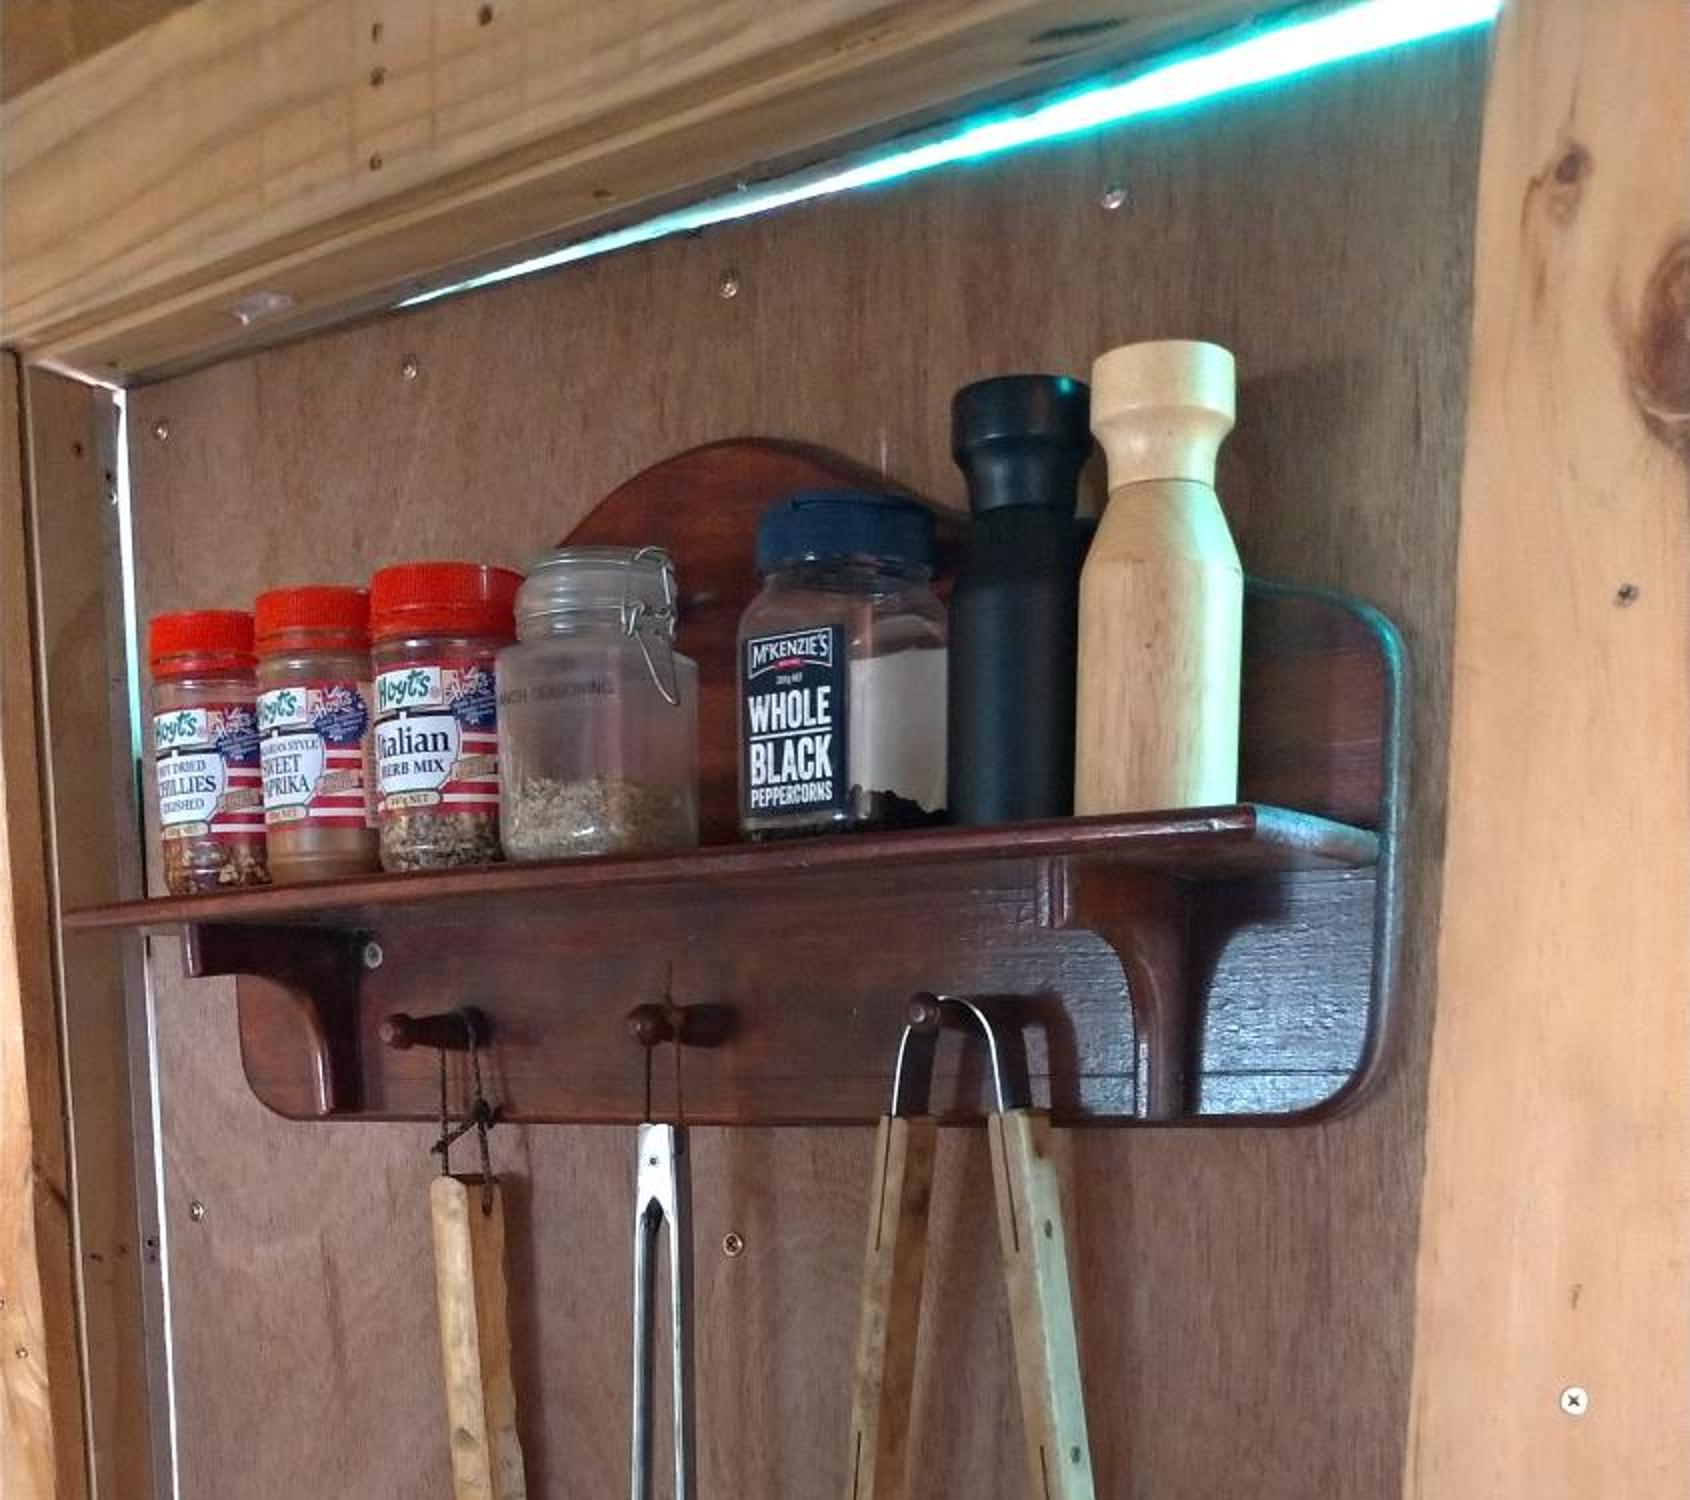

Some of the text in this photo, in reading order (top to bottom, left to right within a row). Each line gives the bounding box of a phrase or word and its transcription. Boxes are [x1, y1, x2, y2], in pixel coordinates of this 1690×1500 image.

[378, 669, 431, 707] Hoyt's
[748, 685, 832, 733] WHOLE
[377, 727, 450, 759] Italian
[751, 733, 833, 786] BLACK
[413, 759, 445, 774] MIX
[751, 780, 833, 809] PEPPERCORNS
